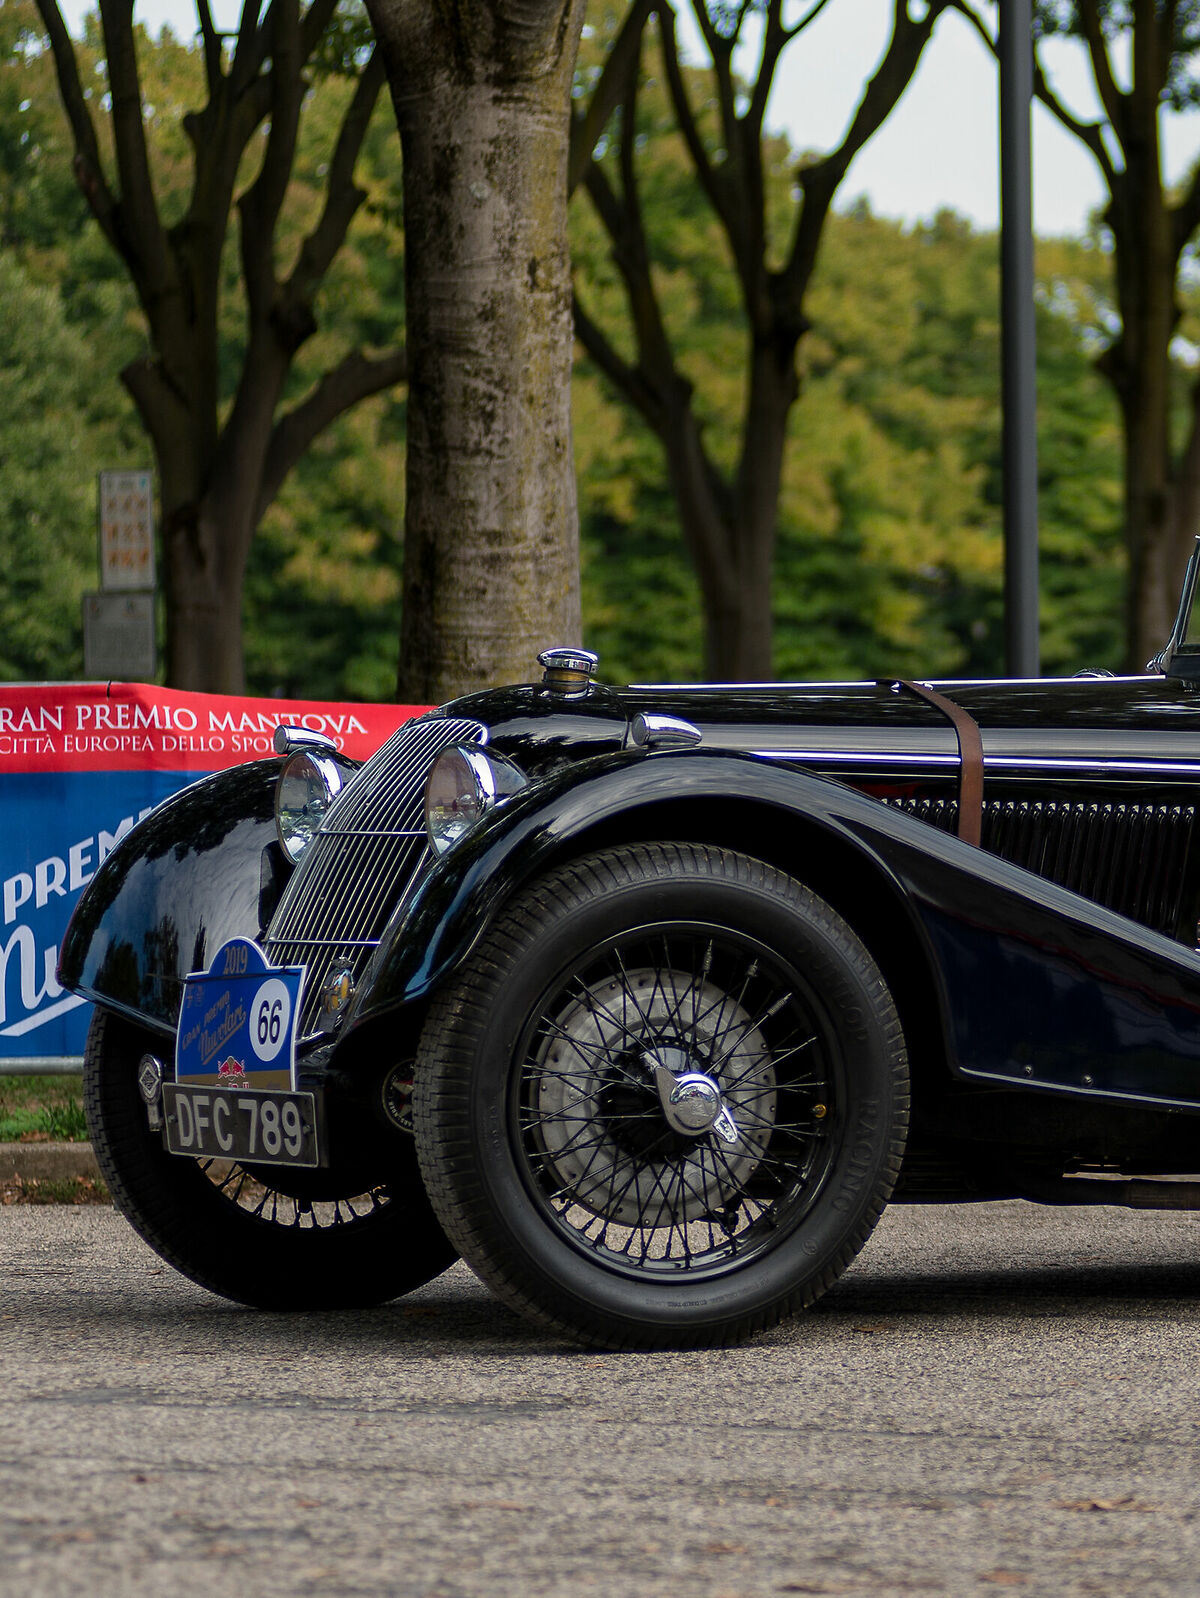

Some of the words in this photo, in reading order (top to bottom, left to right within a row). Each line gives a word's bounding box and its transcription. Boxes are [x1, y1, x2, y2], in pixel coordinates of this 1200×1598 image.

[0, 705, 63, 732] RAN
[75, 704, 198, 732] PREMIO
[208, 710, 369, 734] MANTOVA
[63, 734, 154, 753] EUROPEA
[161, 735, 225, 753] DELLO
[231, 735, 275, 753] SPO
[3, 806, 153, 925] PREM
[222, 945, 249, 975] 2019
[257, 999, 283, 1045] 66
[175, 1093, 233, 1151] DFC
[238, 1099, 301, 1158] 789
